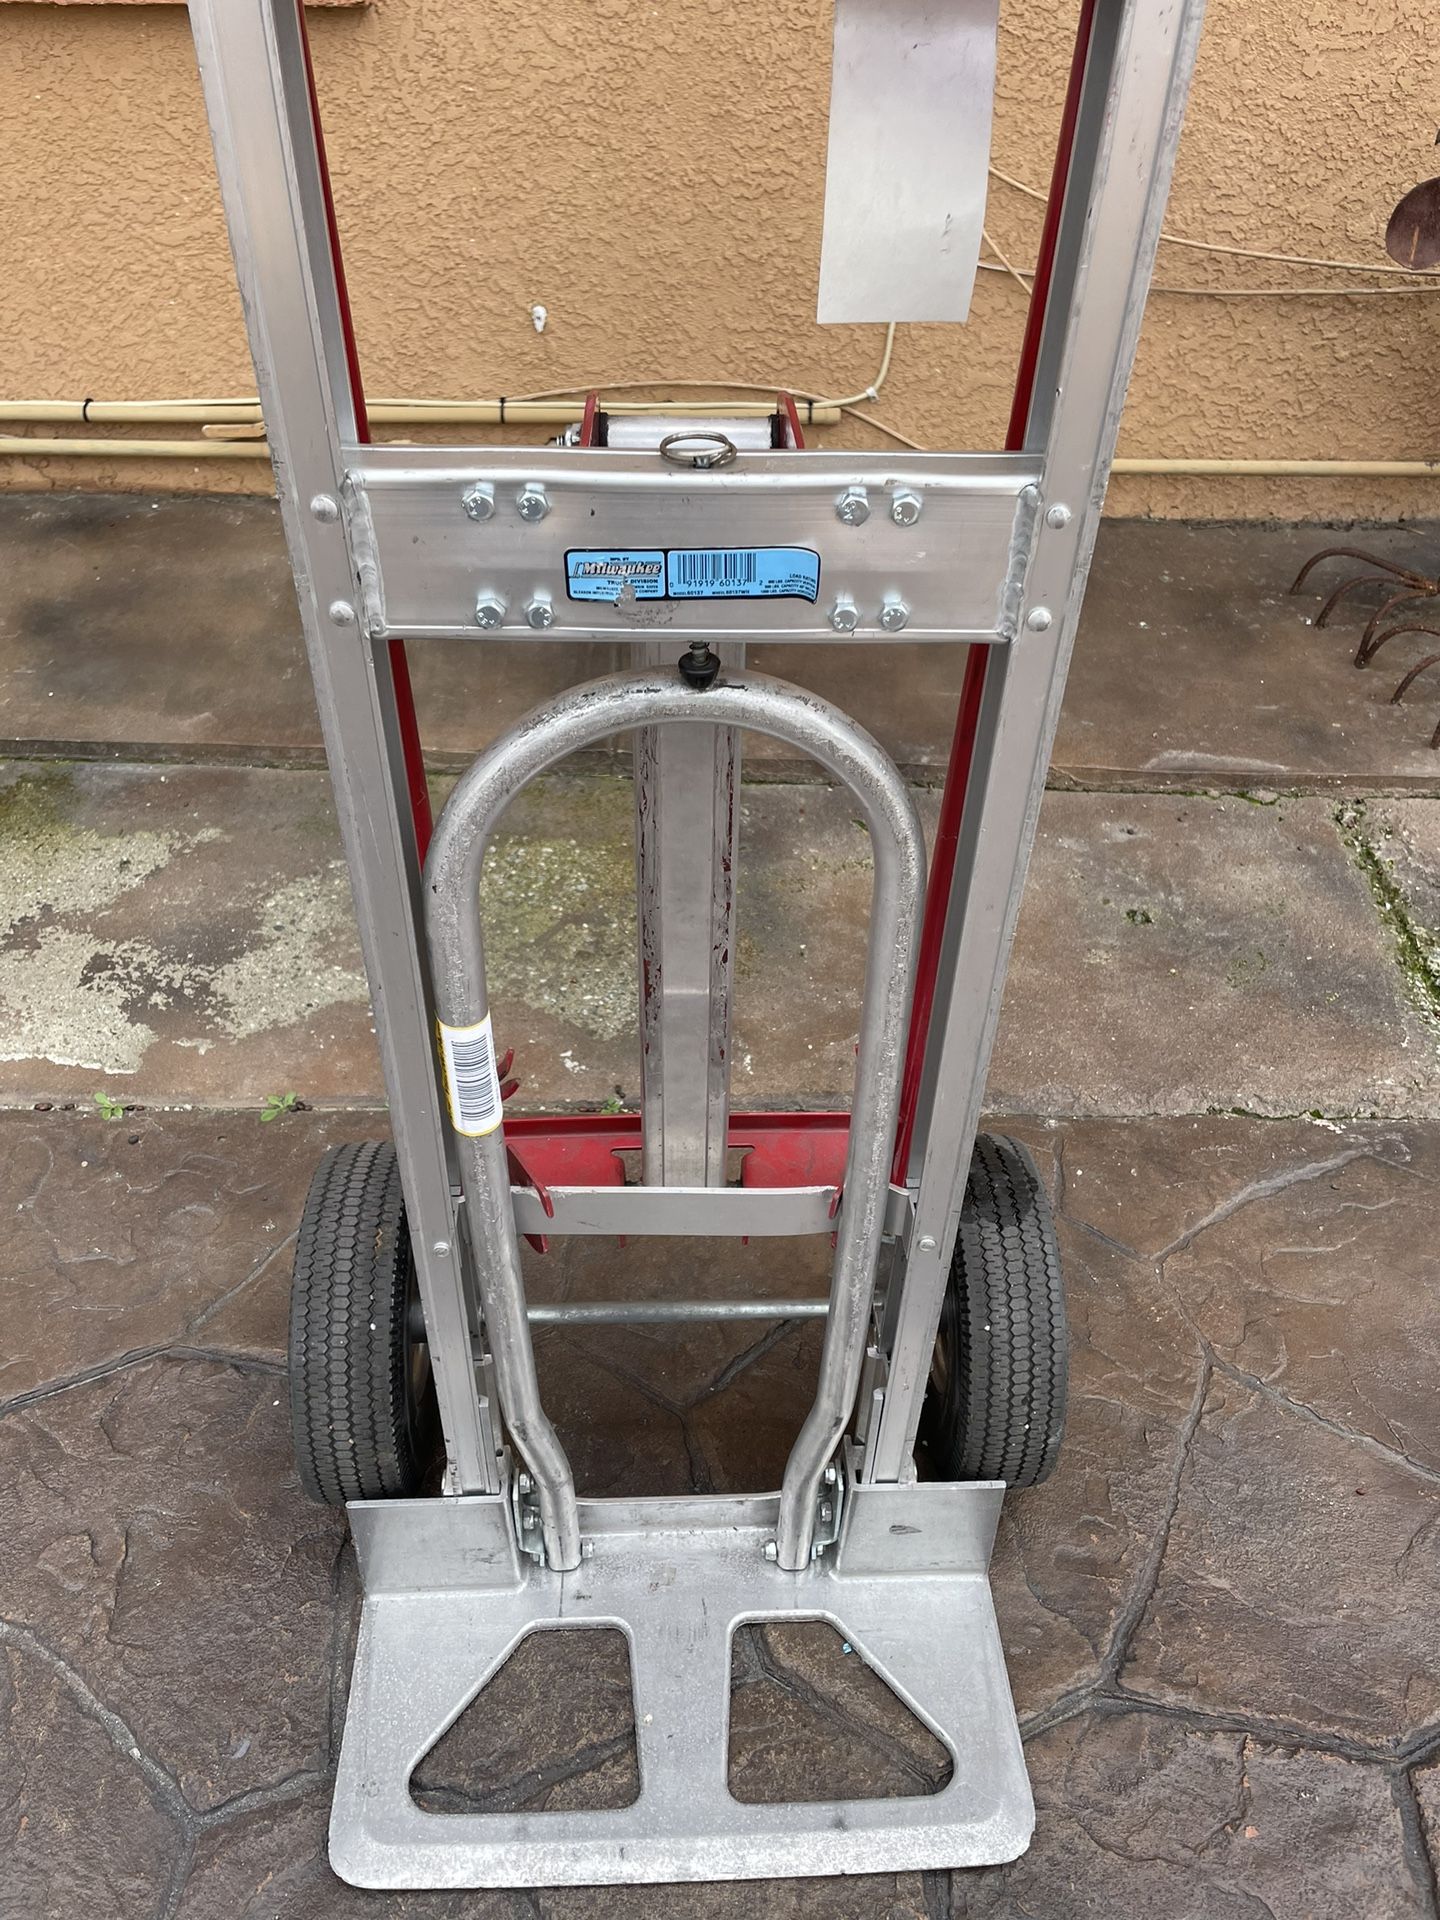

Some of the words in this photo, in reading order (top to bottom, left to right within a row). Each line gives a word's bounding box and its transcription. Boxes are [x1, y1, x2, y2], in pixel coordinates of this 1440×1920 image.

[582, 561, 662, 577] Milwaukee
[687, 579, 715, 588] 91919
[719, 579, 748, 587] 60137
